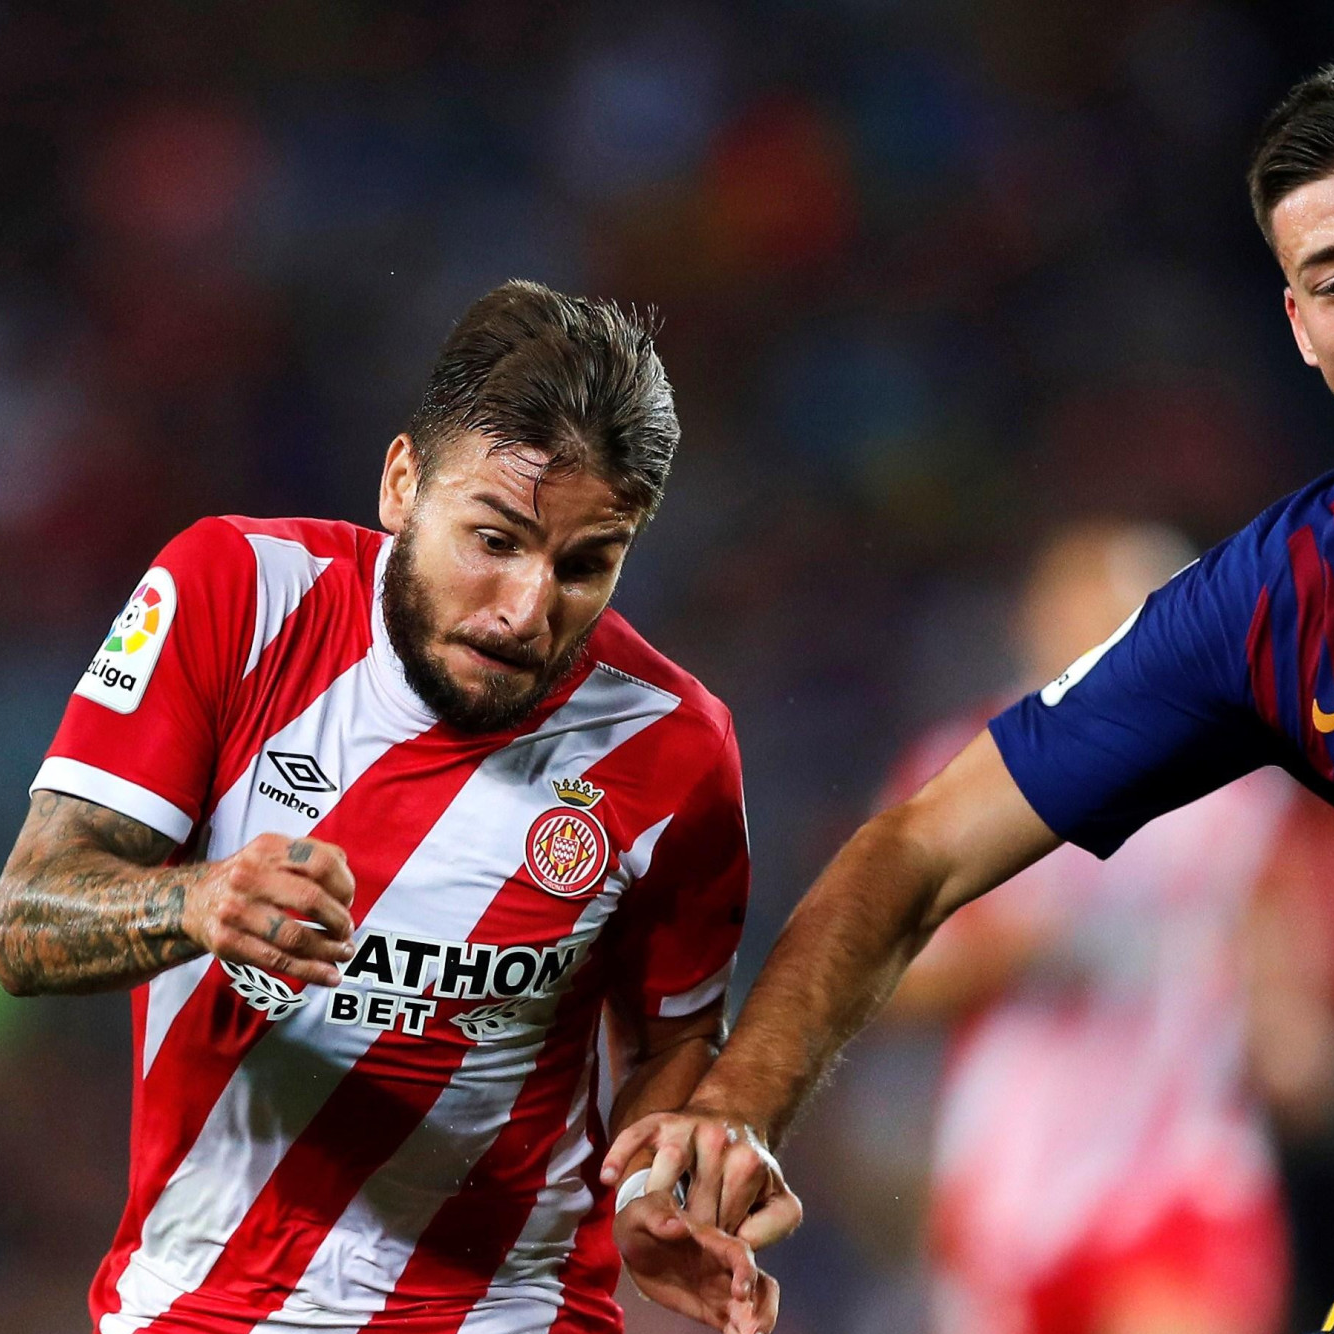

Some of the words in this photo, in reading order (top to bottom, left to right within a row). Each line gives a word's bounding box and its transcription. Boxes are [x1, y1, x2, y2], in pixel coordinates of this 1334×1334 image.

[258, 781, 319, 819] umbro
[343, 934, 576, 996] ATHON
[331, 994, 430, 1030] BET
